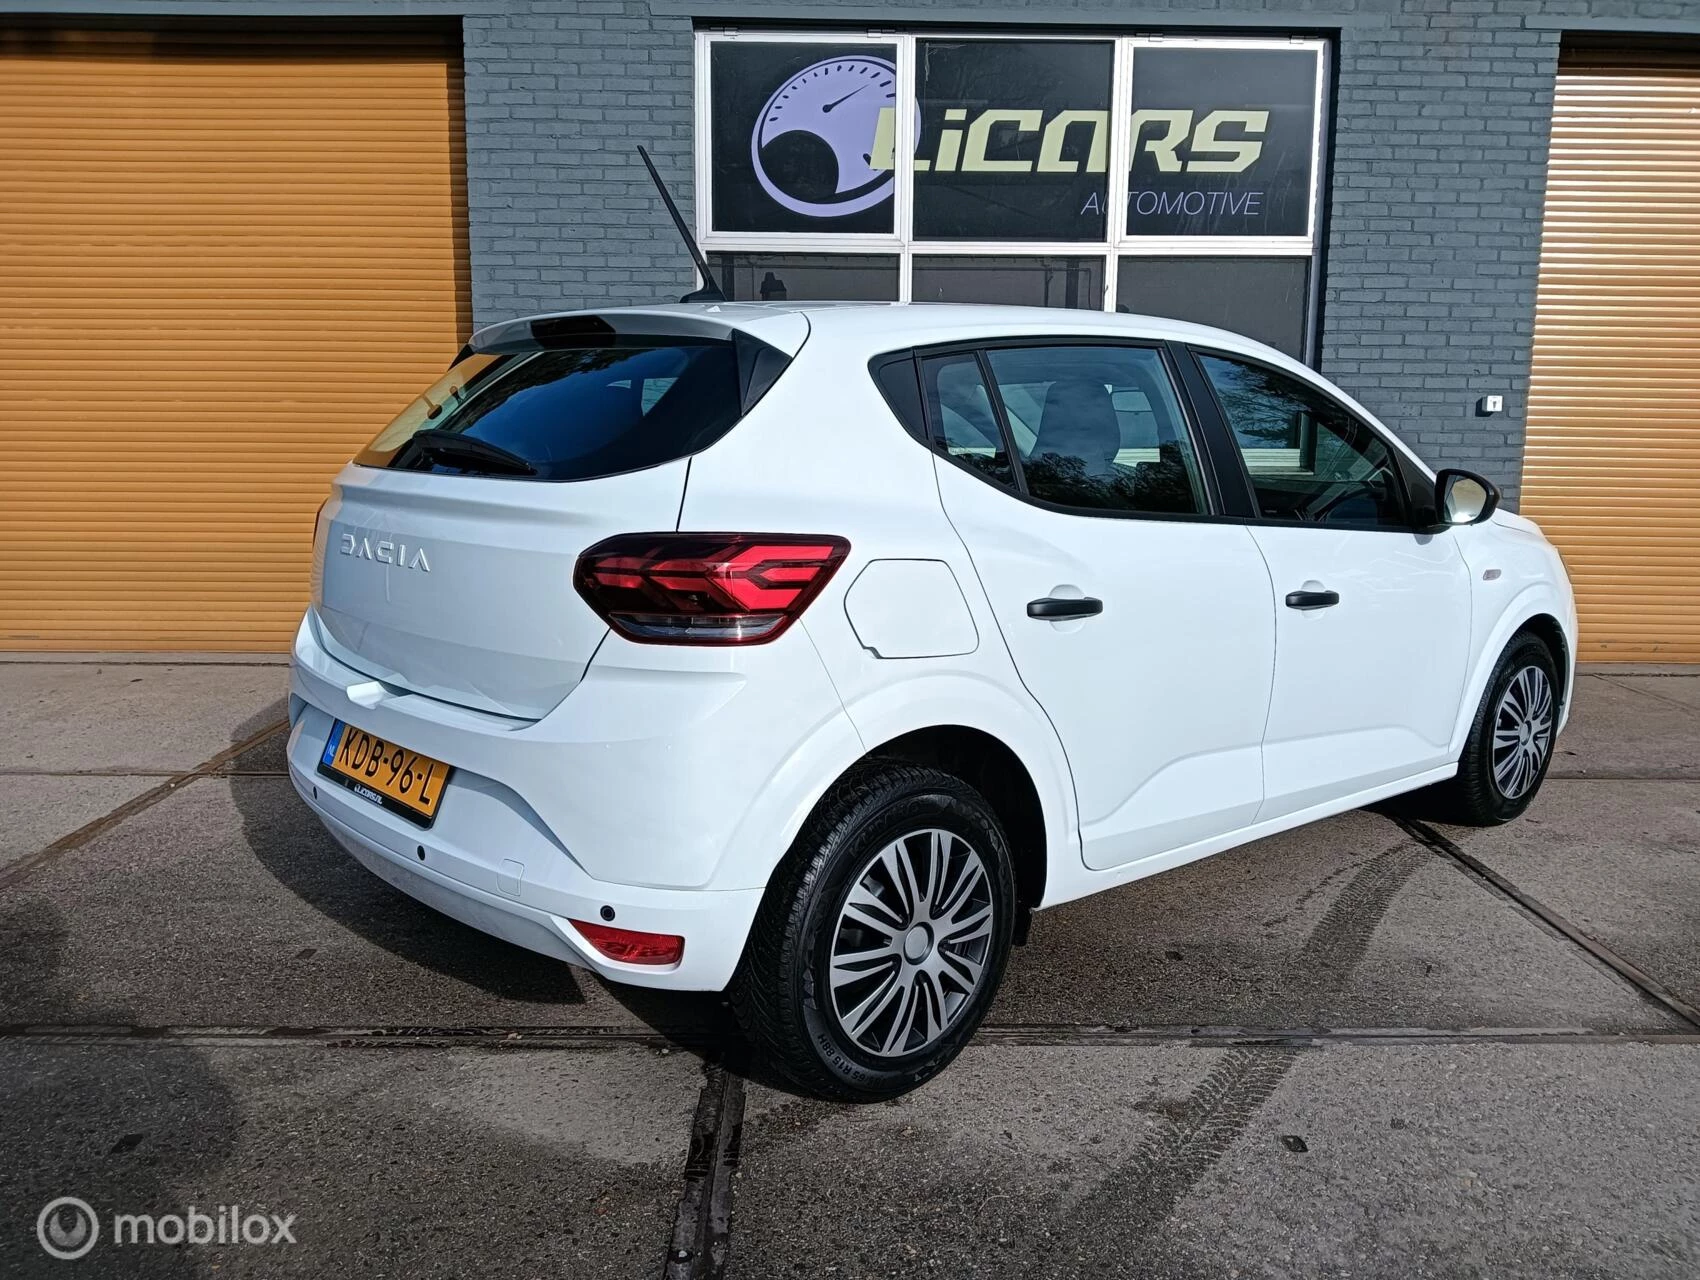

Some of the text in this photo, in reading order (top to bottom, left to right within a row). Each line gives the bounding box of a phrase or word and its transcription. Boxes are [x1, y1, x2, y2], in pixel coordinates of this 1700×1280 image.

[1080, 191, 1264, 215] ATOMOTIVE
[341, 533, 431, 572] DACIA
[339, 727, 431, 805] KDB-96-L
[817, 1034, 836, 1057] 88H
[832, 1056, 852, 1075] R15
